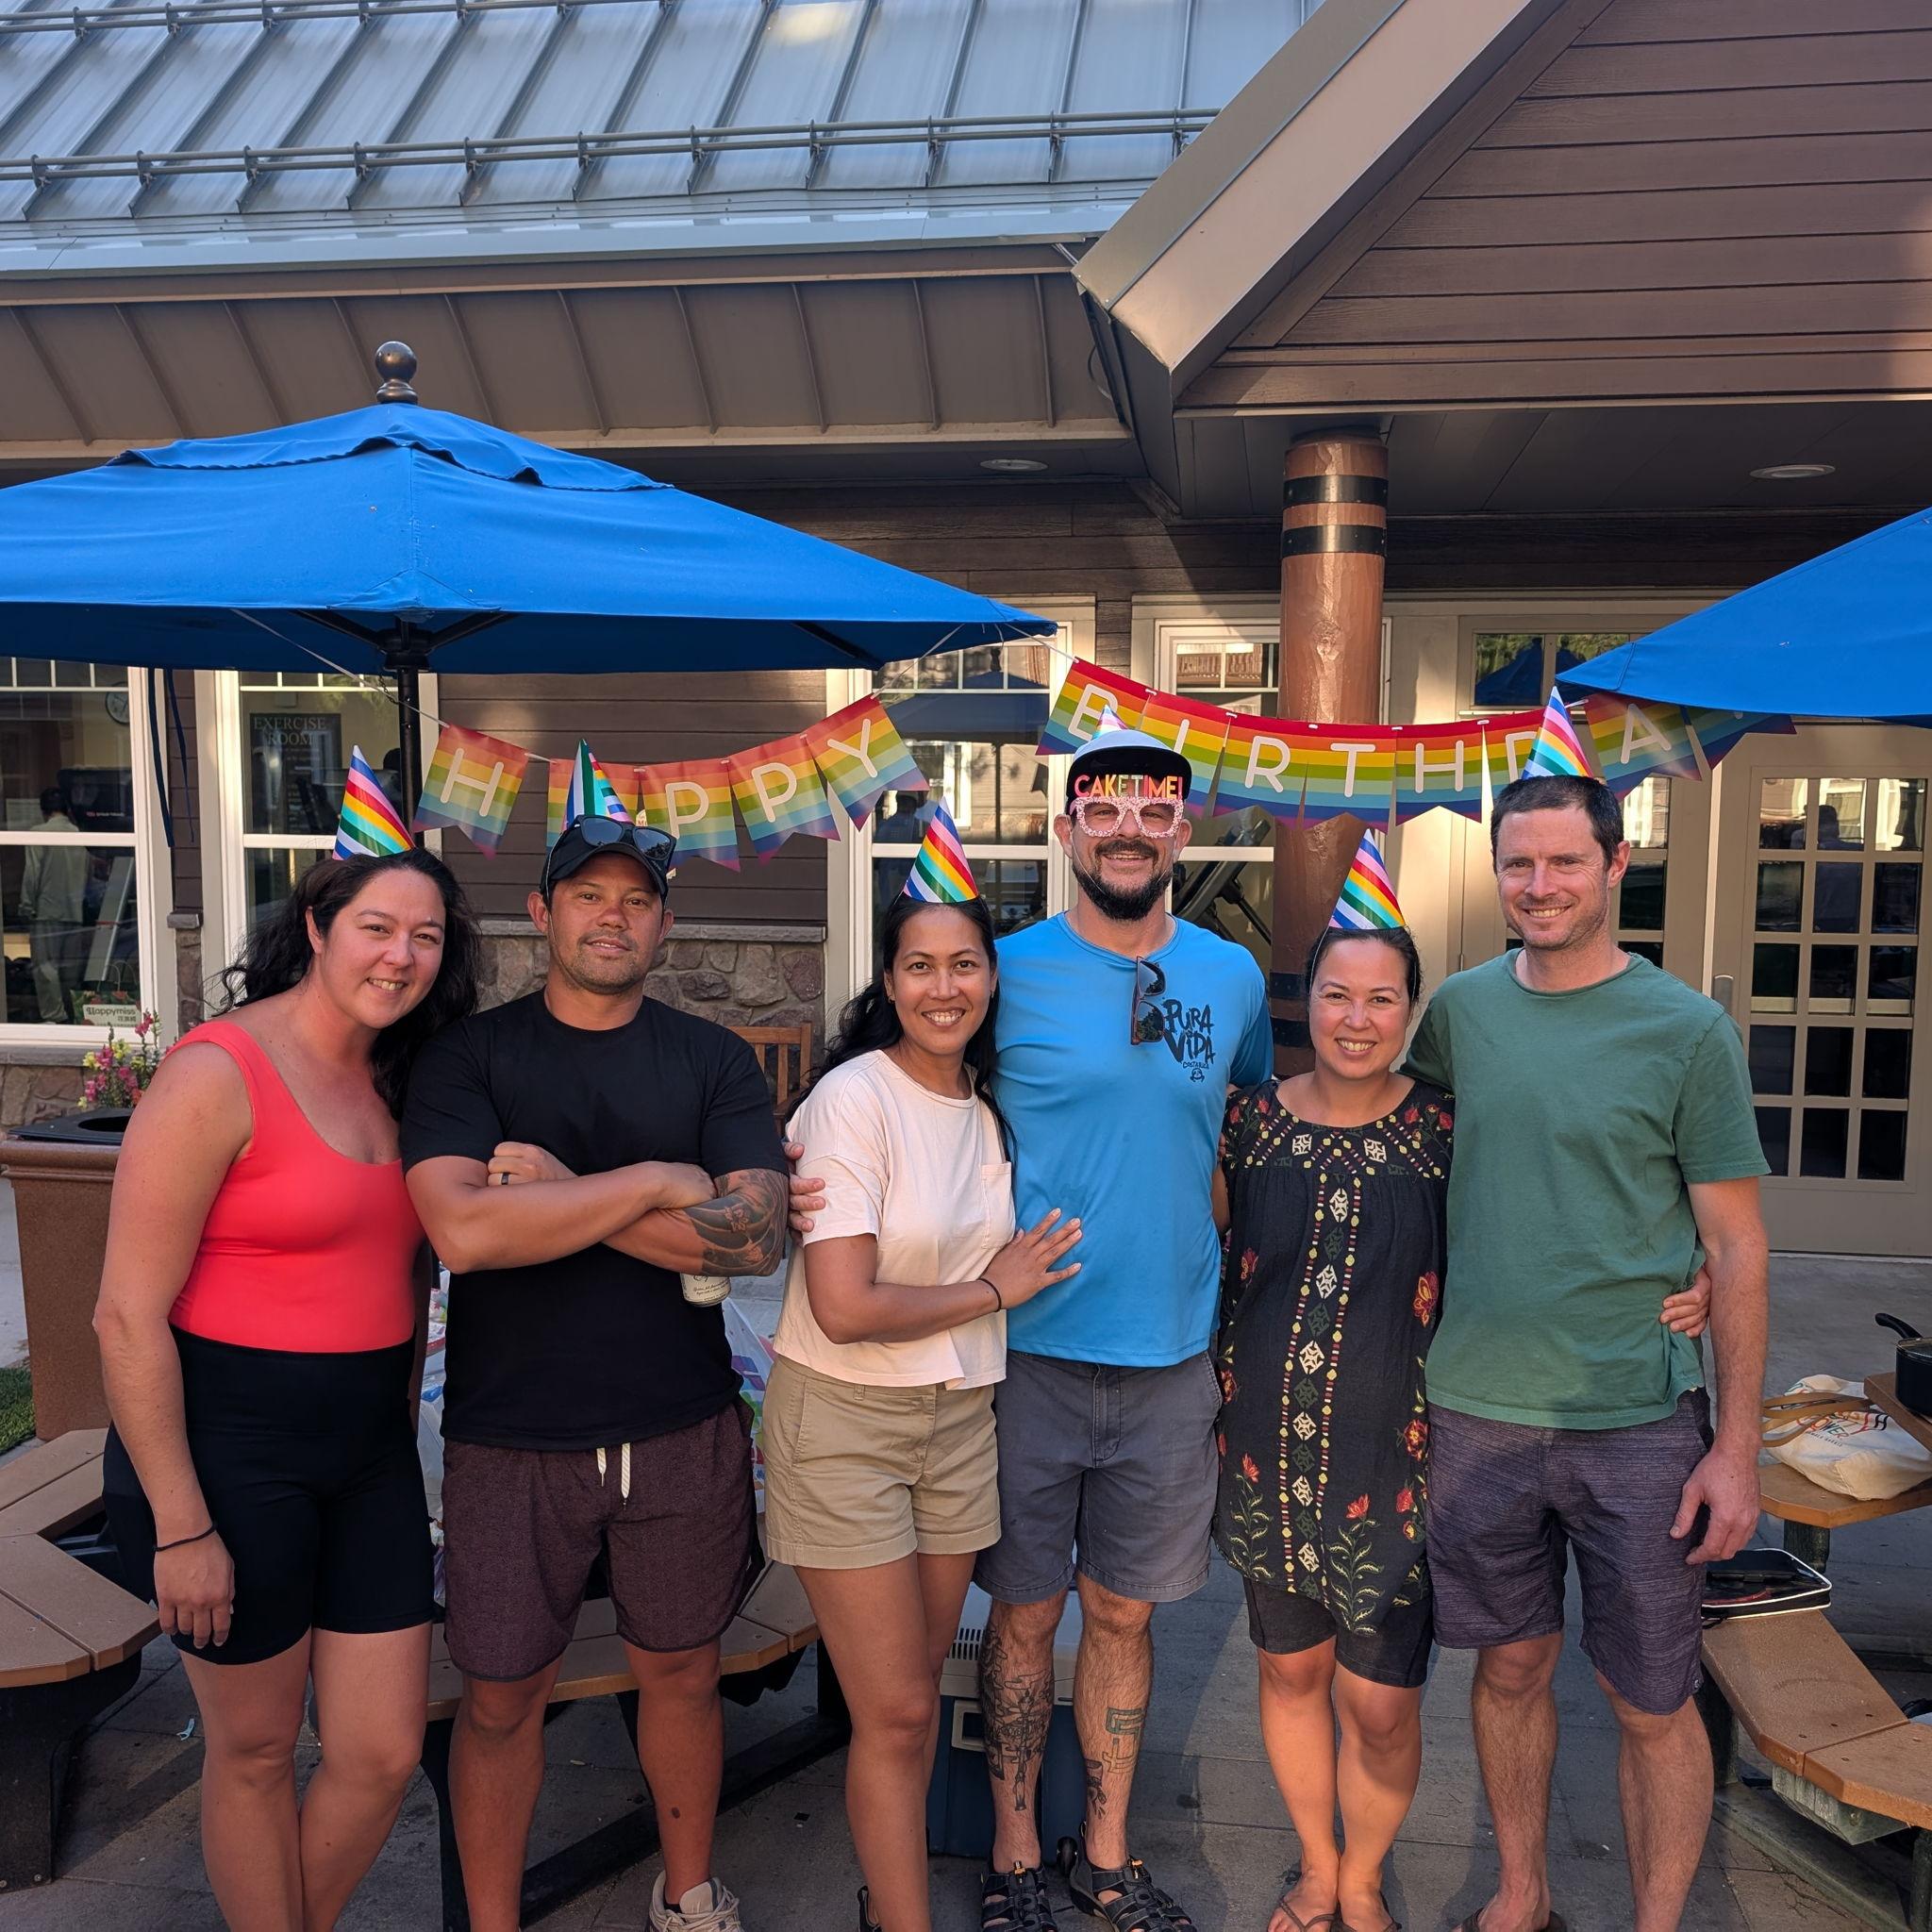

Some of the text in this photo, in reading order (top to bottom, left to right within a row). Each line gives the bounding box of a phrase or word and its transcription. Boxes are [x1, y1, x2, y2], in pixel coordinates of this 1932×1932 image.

[254, 717, 326, 730] EXERCISE
[268, 732, 313, 745] ROOM
[440, 683, 1743, 839] HPPY BIRTHA
[1161, 998, 1215, 1036] PURA
[1163, 1027, 1216, 1064] VIDA
